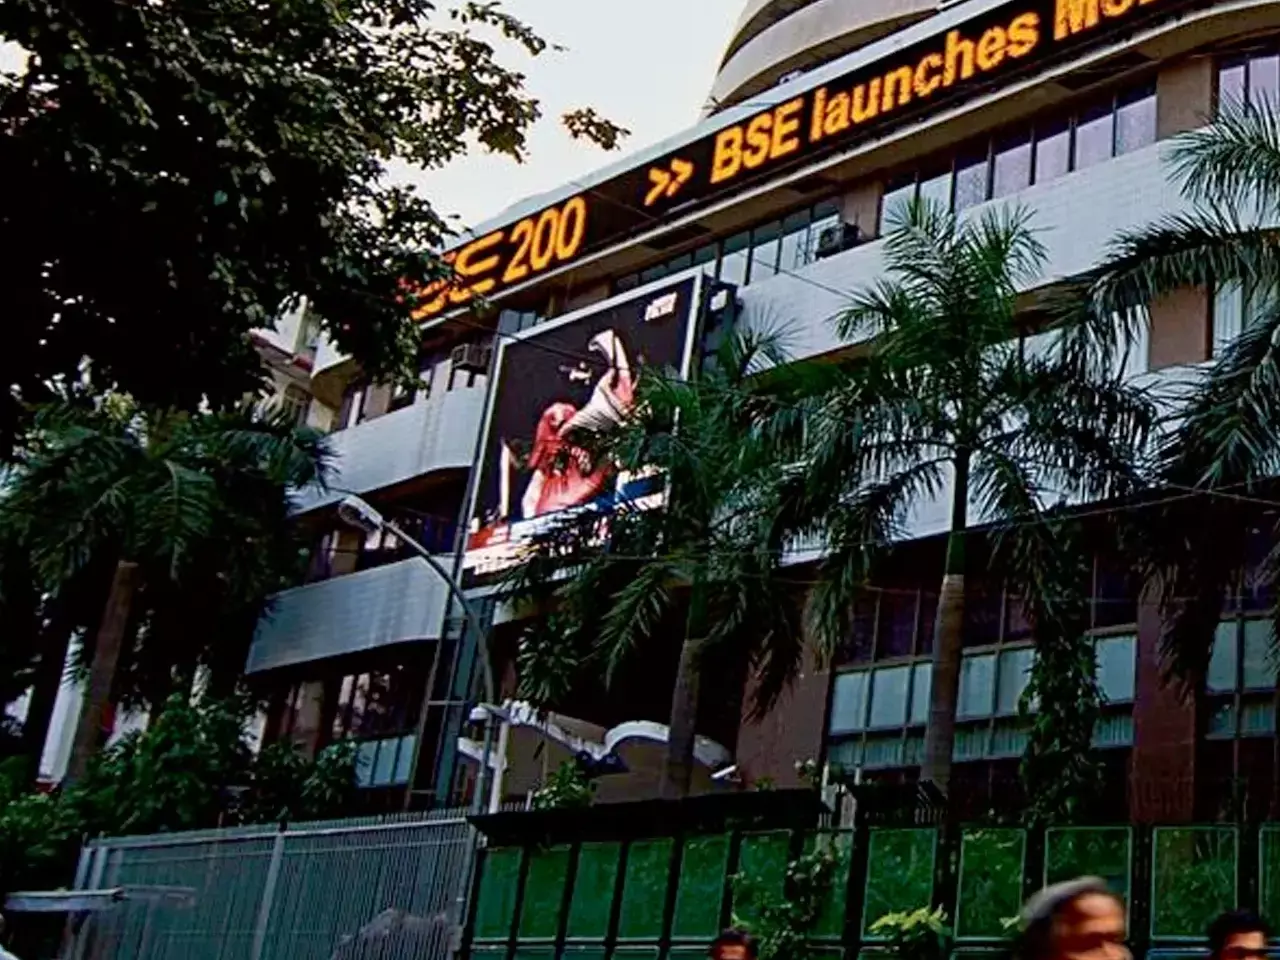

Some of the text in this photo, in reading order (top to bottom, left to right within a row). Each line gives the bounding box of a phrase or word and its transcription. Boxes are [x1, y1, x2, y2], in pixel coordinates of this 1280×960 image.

[709, 97, 804, 185] BSE
[808, 11, 1040, 142] launches
[501, 196, 587, 284] 200
